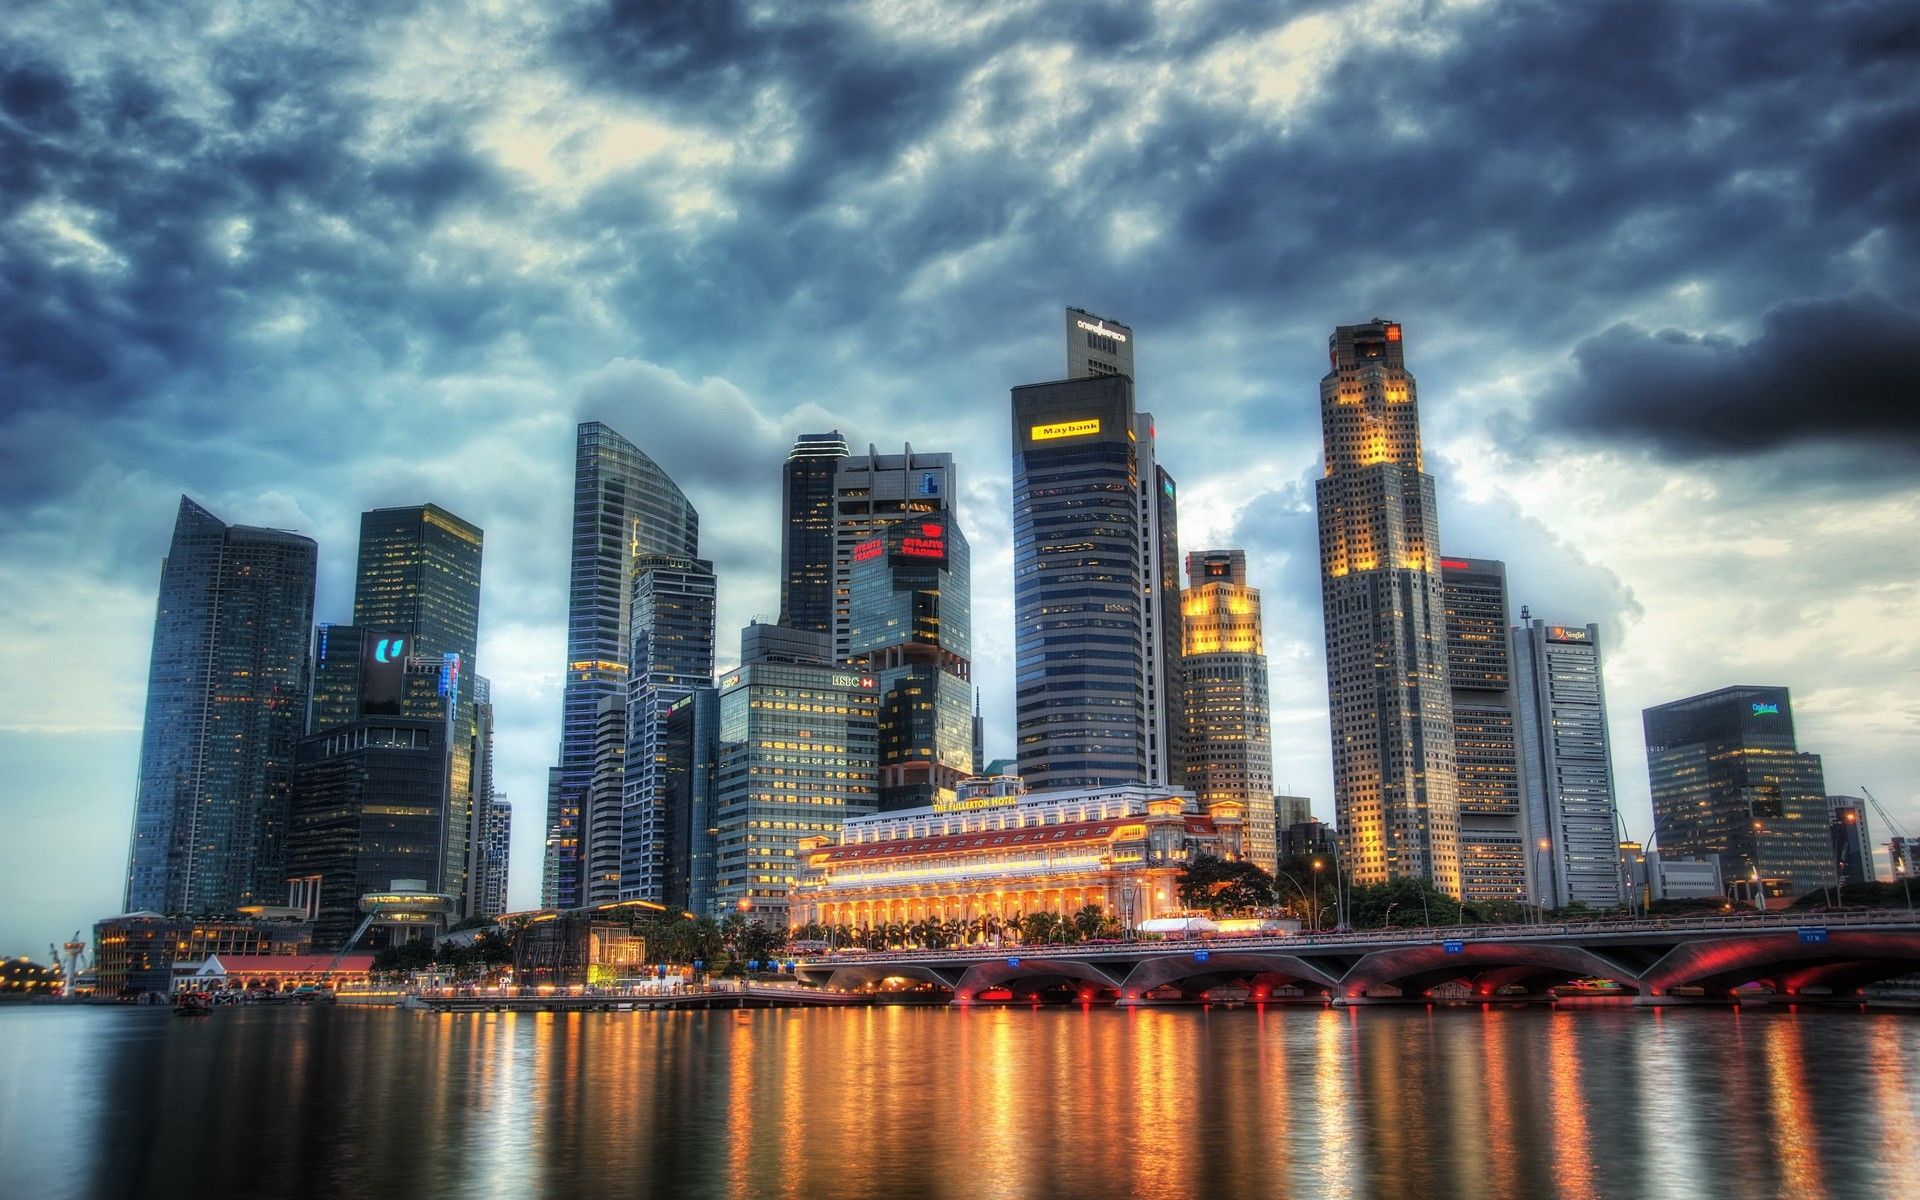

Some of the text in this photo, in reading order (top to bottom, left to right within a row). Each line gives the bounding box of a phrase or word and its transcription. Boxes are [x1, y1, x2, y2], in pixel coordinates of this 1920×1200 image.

[1043, 423, 1097, 435] Maybank
[832, 674, 859, 687] HSBC
[934, 796, 1016, 813] THE FULLERTON HOTEL
